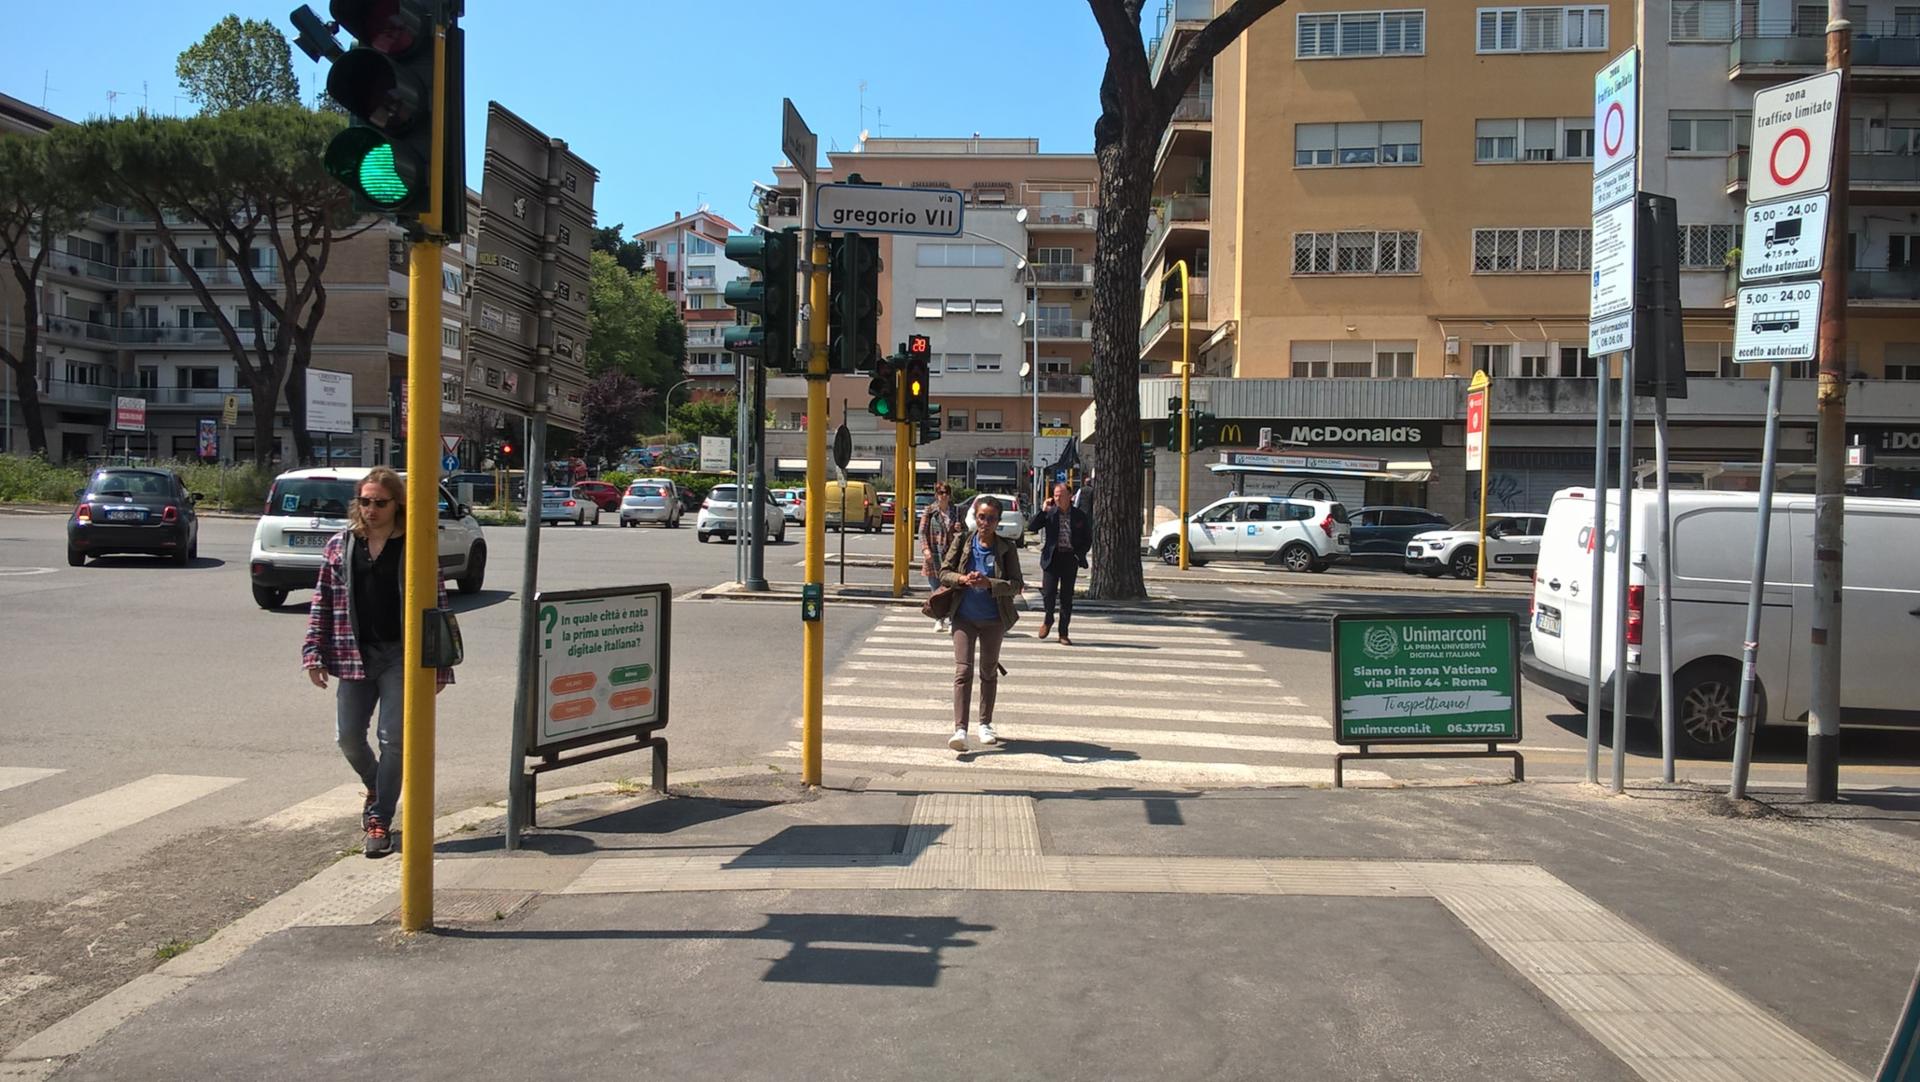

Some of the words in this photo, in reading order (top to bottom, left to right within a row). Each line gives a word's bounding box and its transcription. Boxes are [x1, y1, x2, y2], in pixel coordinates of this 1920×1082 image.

[1785, 89, 1806, 103] zona
[1758, 111, 1792, 128] traffico
[1794, 99, 1832, 119] limitato
[938, 195, 953, 203] via
[833, 208, 916, 225] gregorio
[925, 209, 953, 227] VII
[1753, 210, 1776, 223] 5,00
[1787, 203, 1818, 217] 24,00
[1746, 263, 1773, 276] eccetto
[1775, 256, 1816, 273] autorizzati
[1746, 293, 1769, 305] 5,00
[1780, 289, 1811, 302] 24,00
[1738, 345, 1765, 358] eccetto
[1767, 344, 1809, 357] autorizzati
[1290, 426, 1421, 443] McDonald's
[561, 615, 571, 626] In
[573, 612, 598, 626] quale
[600, 609, 620, 621] città
[629, 607, 648, 618] nata
[562, 631, 571, 641] la
[573, 628, 599, 642] prima
[602, 621, 644, 636] università
[1402, 625, 1487, 642] Unimarconi
[568, 643, 602, 658] digitale
[604, 638, 641, 651] italiana?
[1442, 641, 1487, 650] UNIVERSITÀ
[1410, 651, 1444, 659] DIGITALE
[1353, 666, 1392, 676] Siamo
[1394, 665, 1407, 676] in
[1409, 667, 1439, 676] zona
[1442, 665, 1498, 675] Vaticano
[1364, 678, 1383, 688] via
[1386, 676, 1422, 688] Plinio
[1424, 678, 1441, 687] 44
[1452, 677, 1487, 687] Roma
[1383, 696, 1397, 711] Ti
[1397, 695, 1472, 717] aspettiamo!
[1350, 723, 1431, 735] unimarconi.it
[1447, 723, 1505, 733] 06.377251
